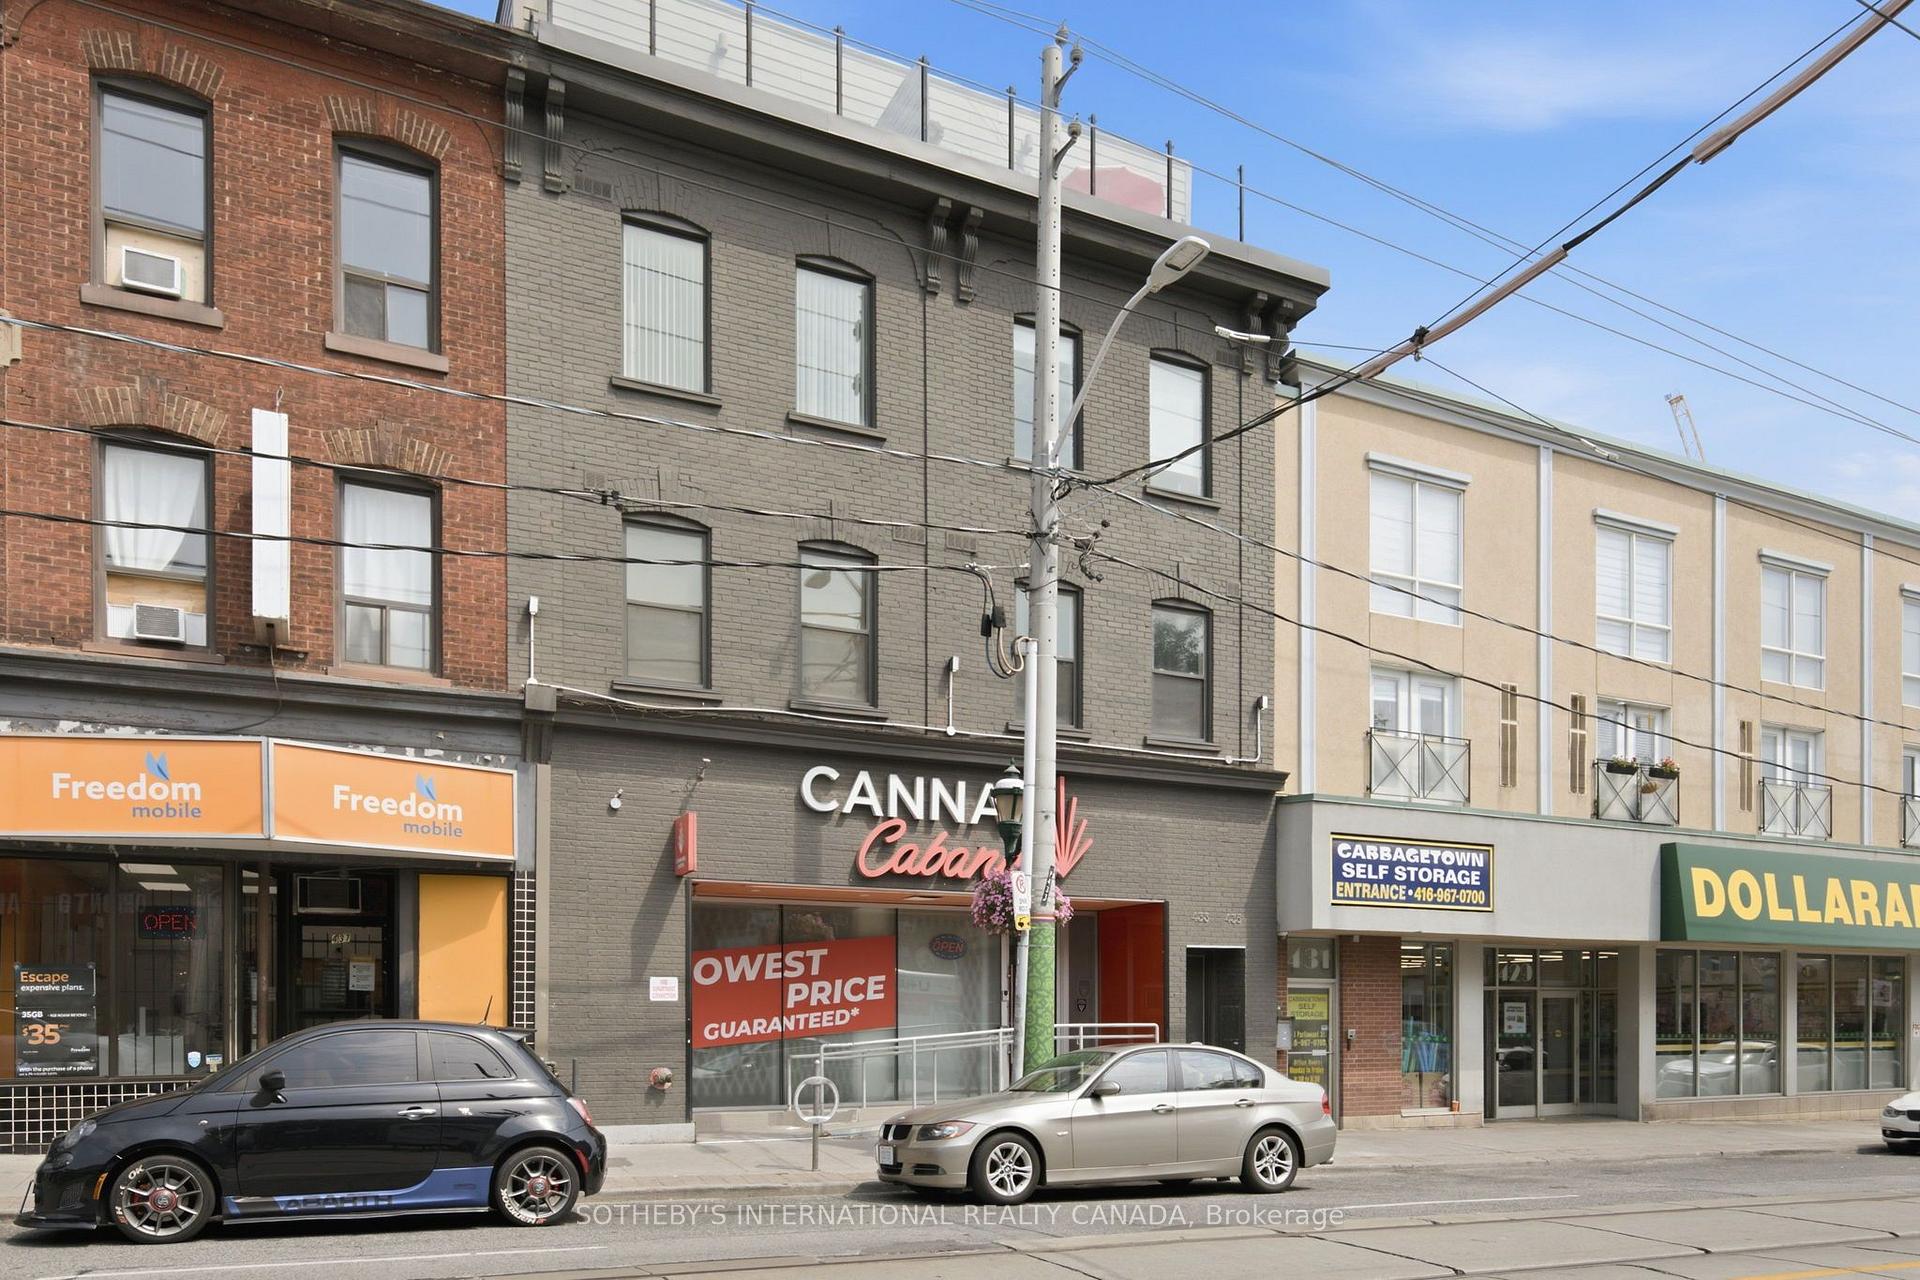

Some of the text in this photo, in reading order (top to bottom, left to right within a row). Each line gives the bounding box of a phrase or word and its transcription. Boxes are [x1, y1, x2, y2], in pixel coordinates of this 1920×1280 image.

[52, 772, 201, 801] Freedom
[132, 803, 202, 818] mobile
[333, 784, 463, 821] Freedom
[403, 820, 463, 837] mobile
[855, 818, 1022, 879] Caban
[1337, 843, 1484, 867] CABBAGETOWN
[1342, 862, 1481, 885] SELF STORAGE
[1336, 881, 1485, 904] ENTRANCE 416-967-0700
[143, 914, 197, 932] OPEN
[20, 971, 70, 985] Escape
[20, 984, 60, 992] expensive
[786, 975, 886, 1009] PRICE
